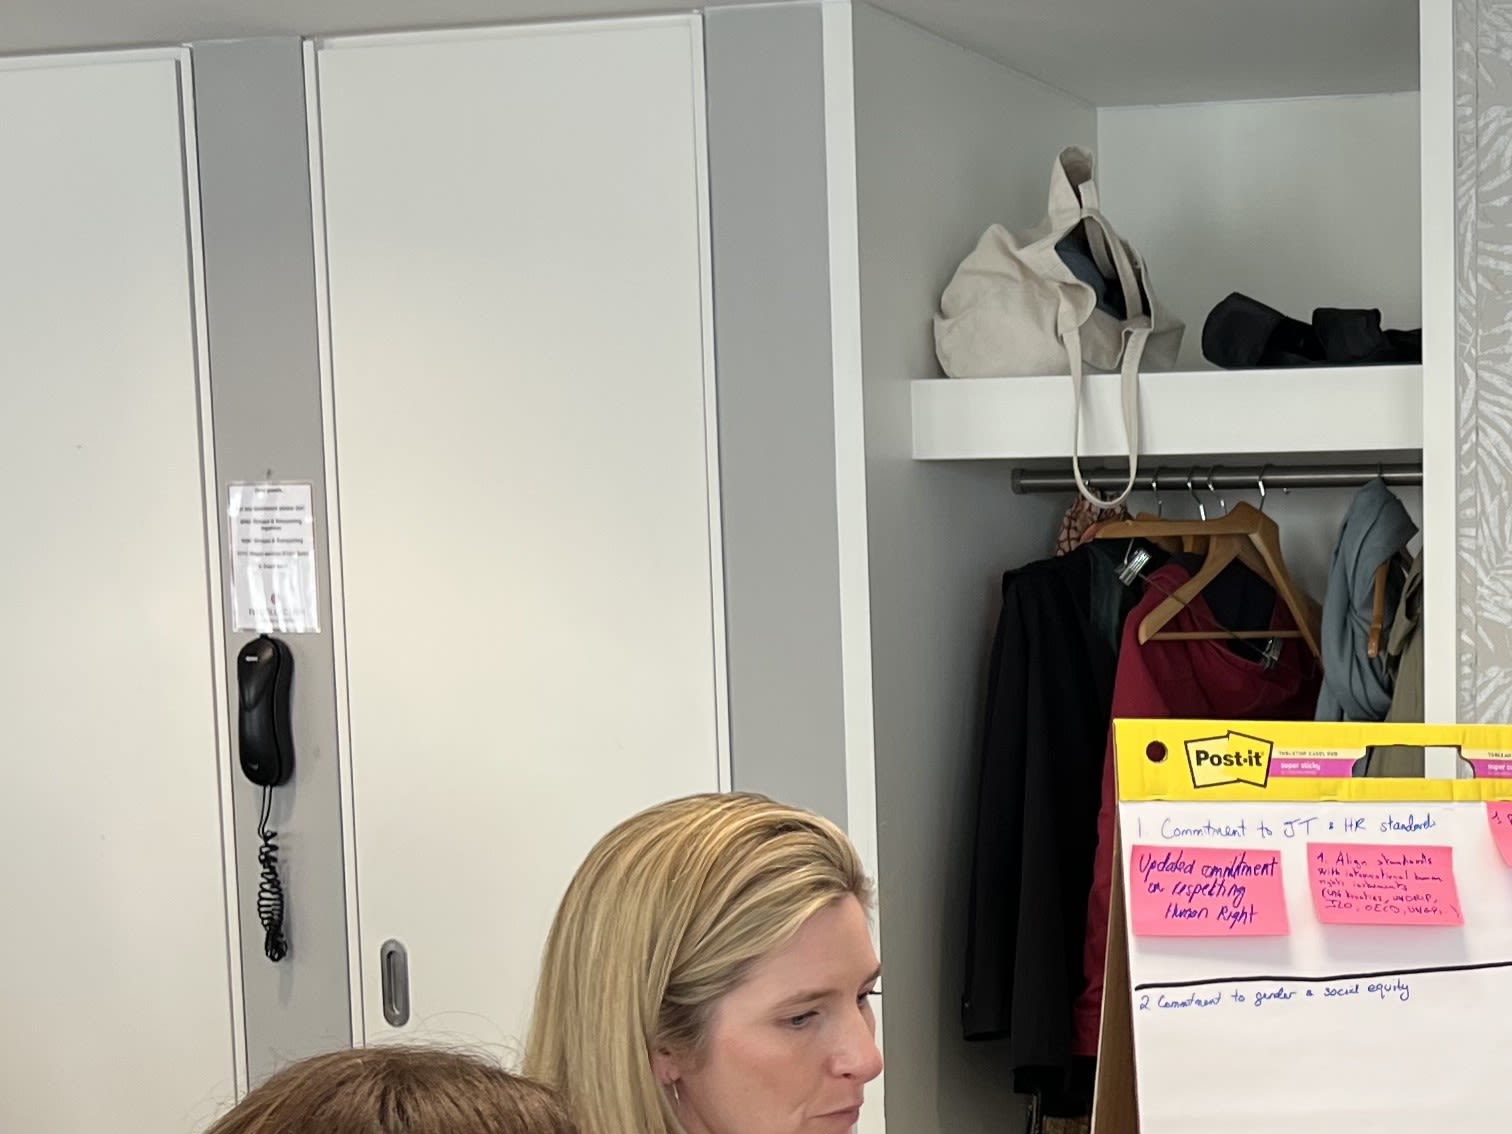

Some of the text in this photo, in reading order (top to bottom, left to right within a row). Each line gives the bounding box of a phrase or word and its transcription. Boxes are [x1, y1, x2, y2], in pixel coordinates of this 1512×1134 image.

[1160, 817, 1247, 840] Commitment
[1256, 821, 1273, 838] to
[1283, 816, 1320, 839] JT
[1343, 816, 1367, 834] HR
[1231, 989, 1246, 1003] to
